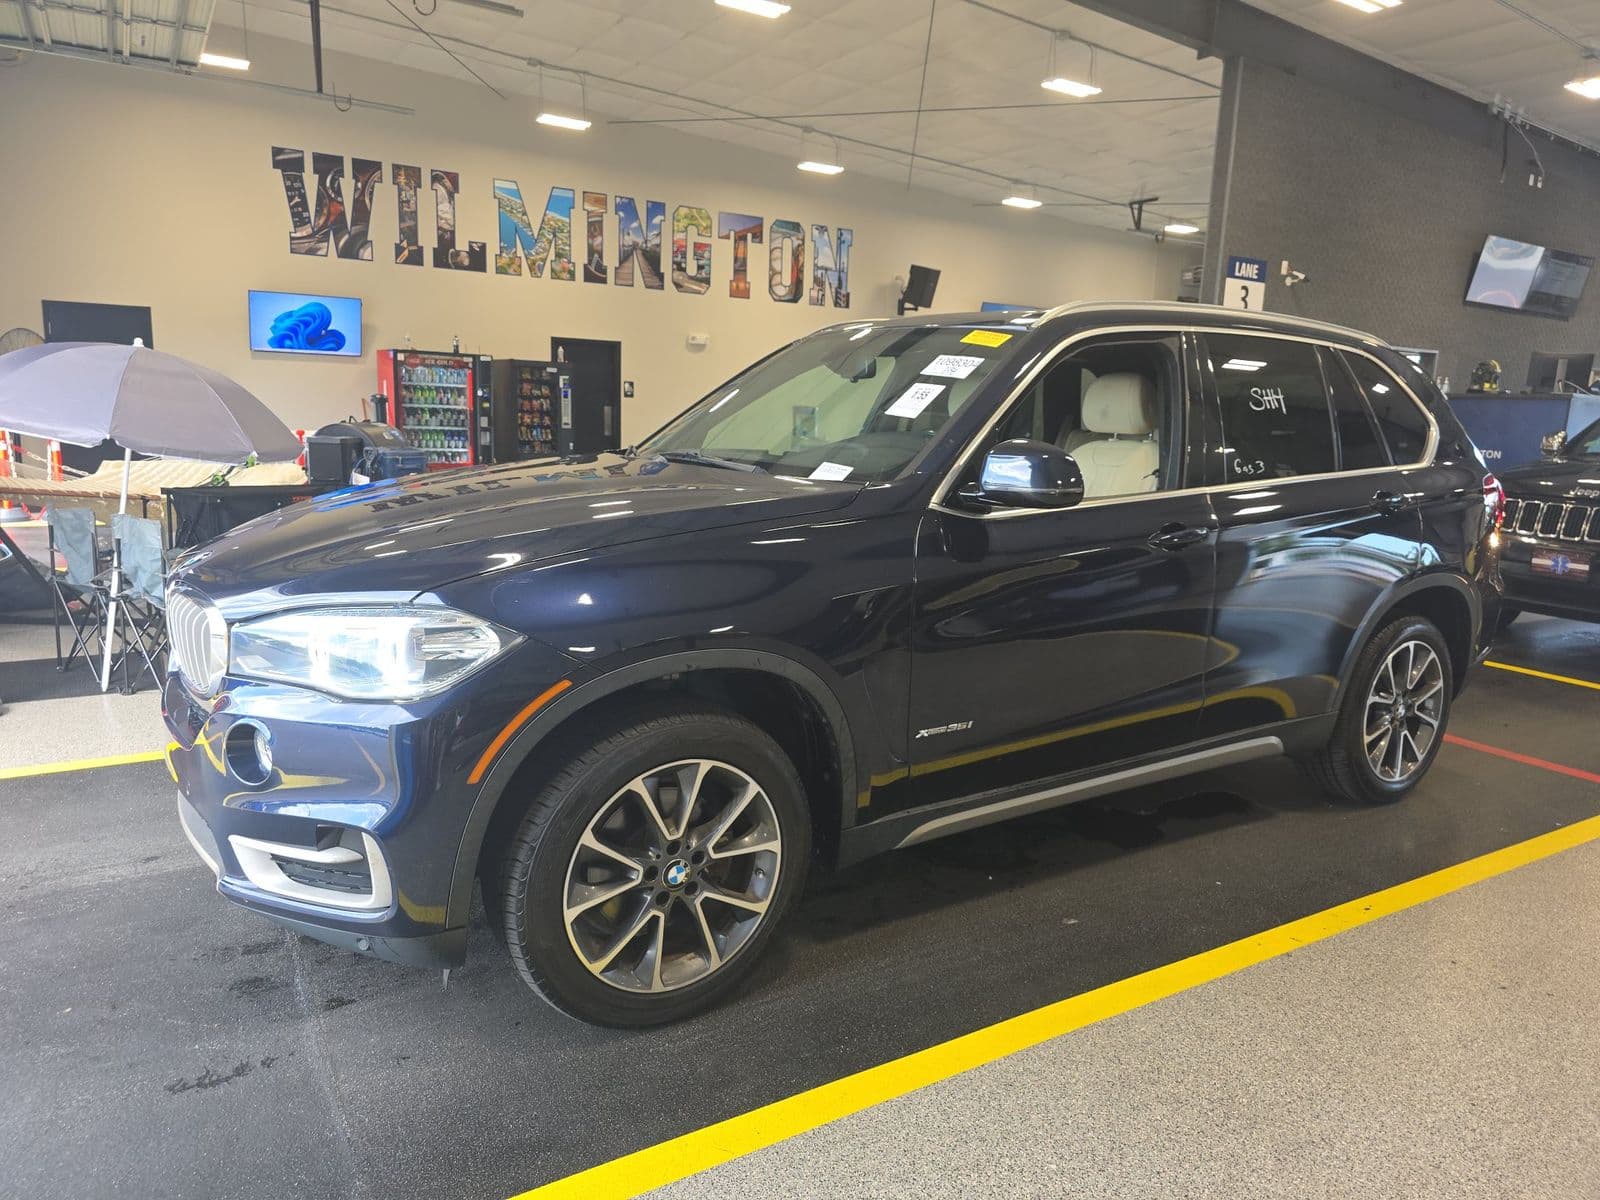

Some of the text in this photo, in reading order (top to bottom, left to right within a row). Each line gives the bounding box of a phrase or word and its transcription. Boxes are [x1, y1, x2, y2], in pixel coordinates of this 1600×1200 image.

[271, 146, 853, 309] WILMINGTON
[1234, 261, 1259, 279] LANE
[1240, 285, 1249, 309] 3
[1480, 449, 1501, 459] TON
[1568, 486, 1600, 499] Jeep
